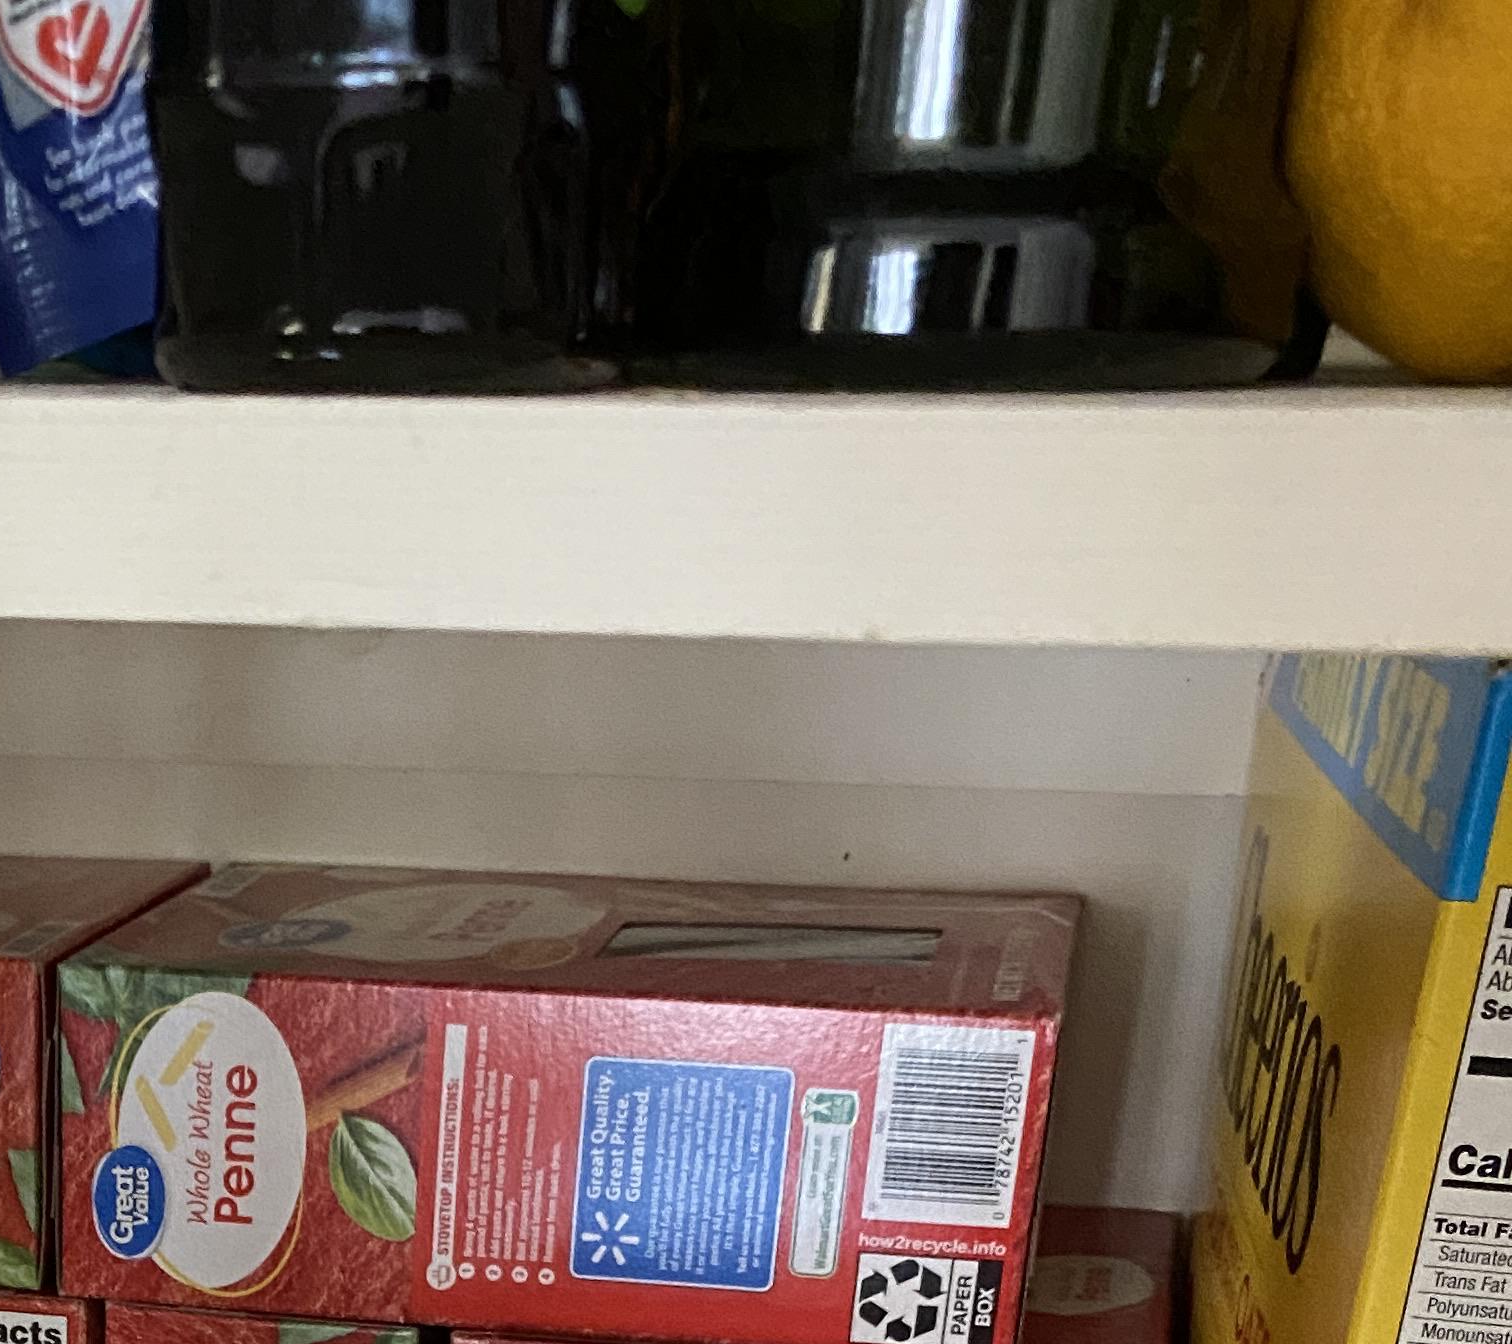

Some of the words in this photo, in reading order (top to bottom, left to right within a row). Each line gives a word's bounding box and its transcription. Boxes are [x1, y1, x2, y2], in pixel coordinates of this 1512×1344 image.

[190, 1059, 215, 1139] Wheat
[590, 1069, 615, 1145] Quality.
[1003, 1072, 1023, 1125] 15201
[214, 1064, 258, 1226] Penne
[441, 1077, 460, 1186] INSTRUCTIONS:
[625, 1086, 651, 1202] Guaranteed.
[188, 1145, 213, 1226] Whole
[587, 1150, 605, 1199] Great
[605, 1150, 625, 1200] Great
[994, 1136, 1015, 1189] 78742
[109, 1164, 135, 1245] Great
[131, 1166, 150, 1227] Value
[437, 1187, 453, 1256] STOVETOP
[858, 1232, 1007, 1256] how2recycle.info
[1434, 1217, 1487, 1238] Total
[951, 1276, 972, 1336] PAPER
[975, 1288, 996, 1327] BOX
[1435, 1271, 1477, 1292] Trans
[1481, 1276, 1507, 1294] Fat
